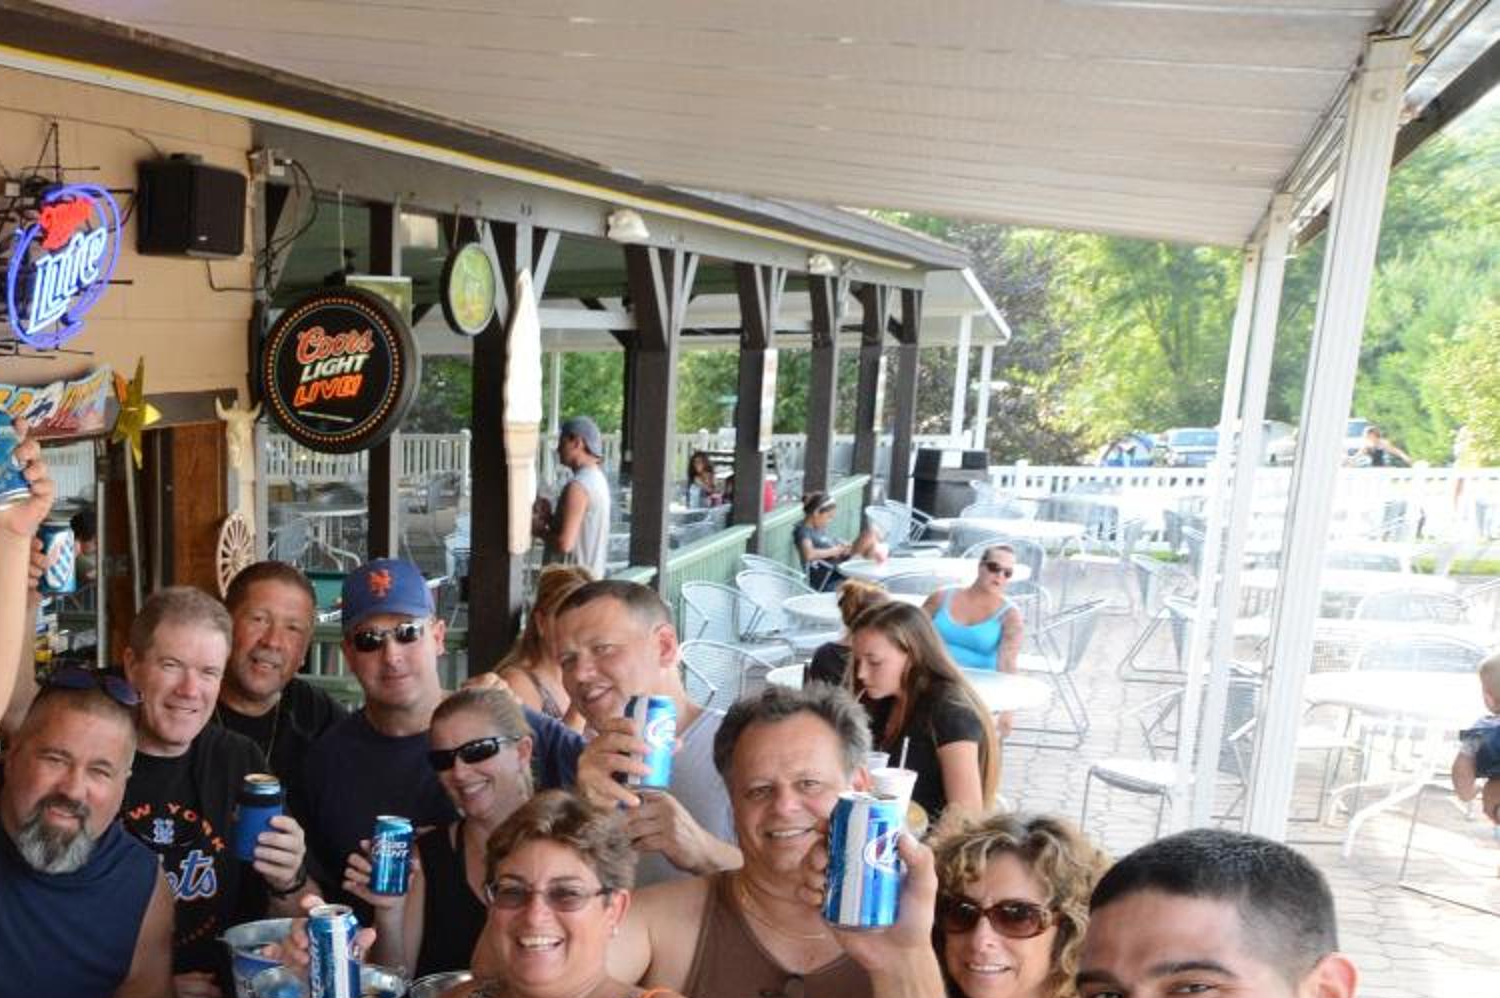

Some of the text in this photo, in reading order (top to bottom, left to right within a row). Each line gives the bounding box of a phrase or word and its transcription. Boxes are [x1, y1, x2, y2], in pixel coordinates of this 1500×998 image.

[296, 325, 376, 366] Coors
[300, 353, 371, 383] LIGHT
[292, 373, 364, 408] LIVE!
